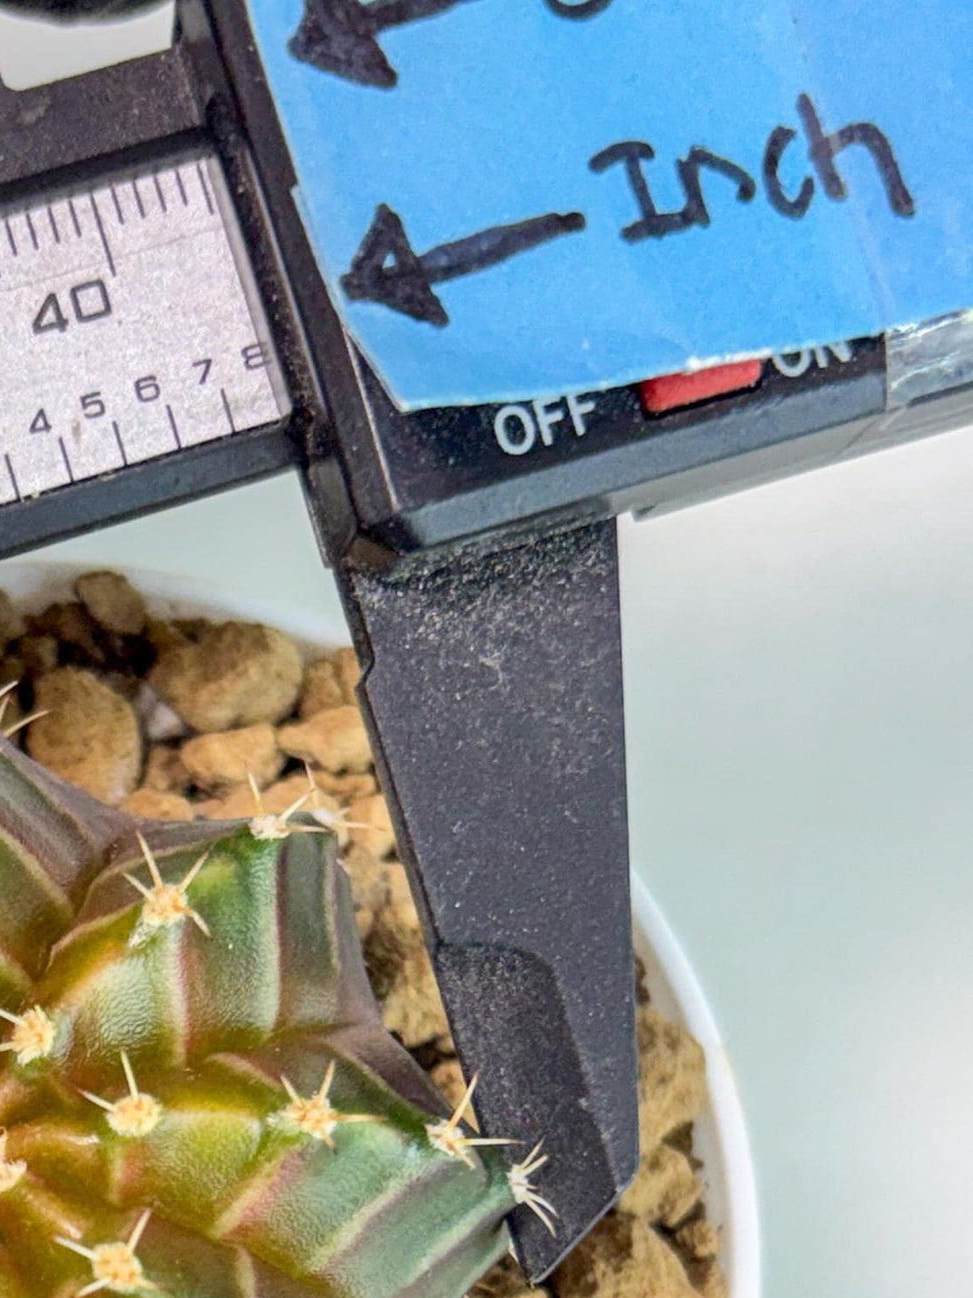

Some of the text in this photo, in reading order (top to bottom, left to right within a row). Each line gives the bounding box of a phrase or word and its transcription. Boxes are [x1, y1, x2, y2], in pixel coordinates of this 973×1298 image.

[587, 93, 916, 244] Inch
[32, 279, 112, 334] 40
[29, 408, 52, 434] 4
[80, 391, 106, 419] 5
[133, 375, 161, 403] 6
[192, 358, 213, 385] 7
[494, 393, 596, 456] OFF
